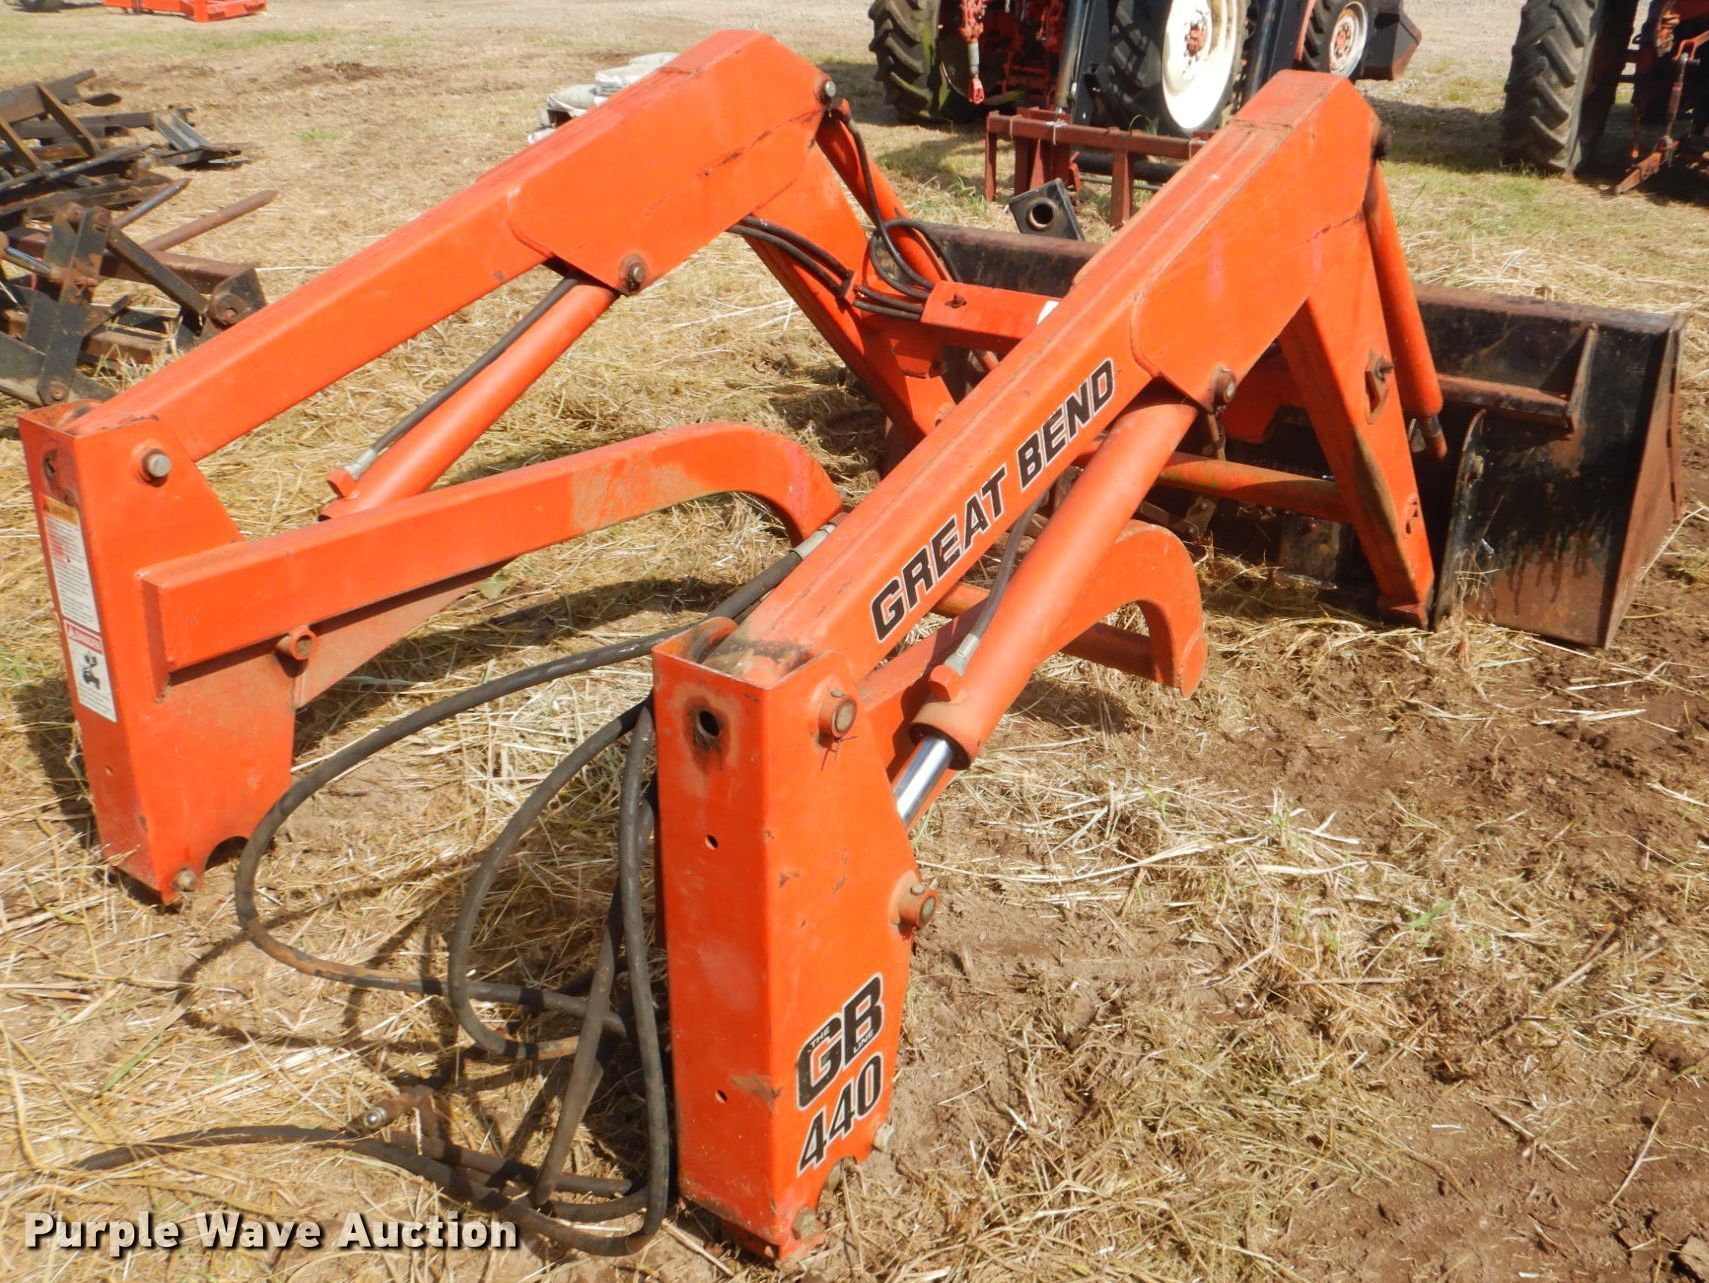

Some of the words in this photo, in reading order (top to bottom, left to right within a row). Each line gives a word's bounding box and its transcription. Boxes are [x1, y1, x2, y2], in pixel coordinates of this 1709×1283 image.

[871, 463, 1007, 642] GREAT
[1016, 358, 1116, 492] BEND
[798, 975, 883, 1109] GB
[798, 1052, 883, 1177] 440
